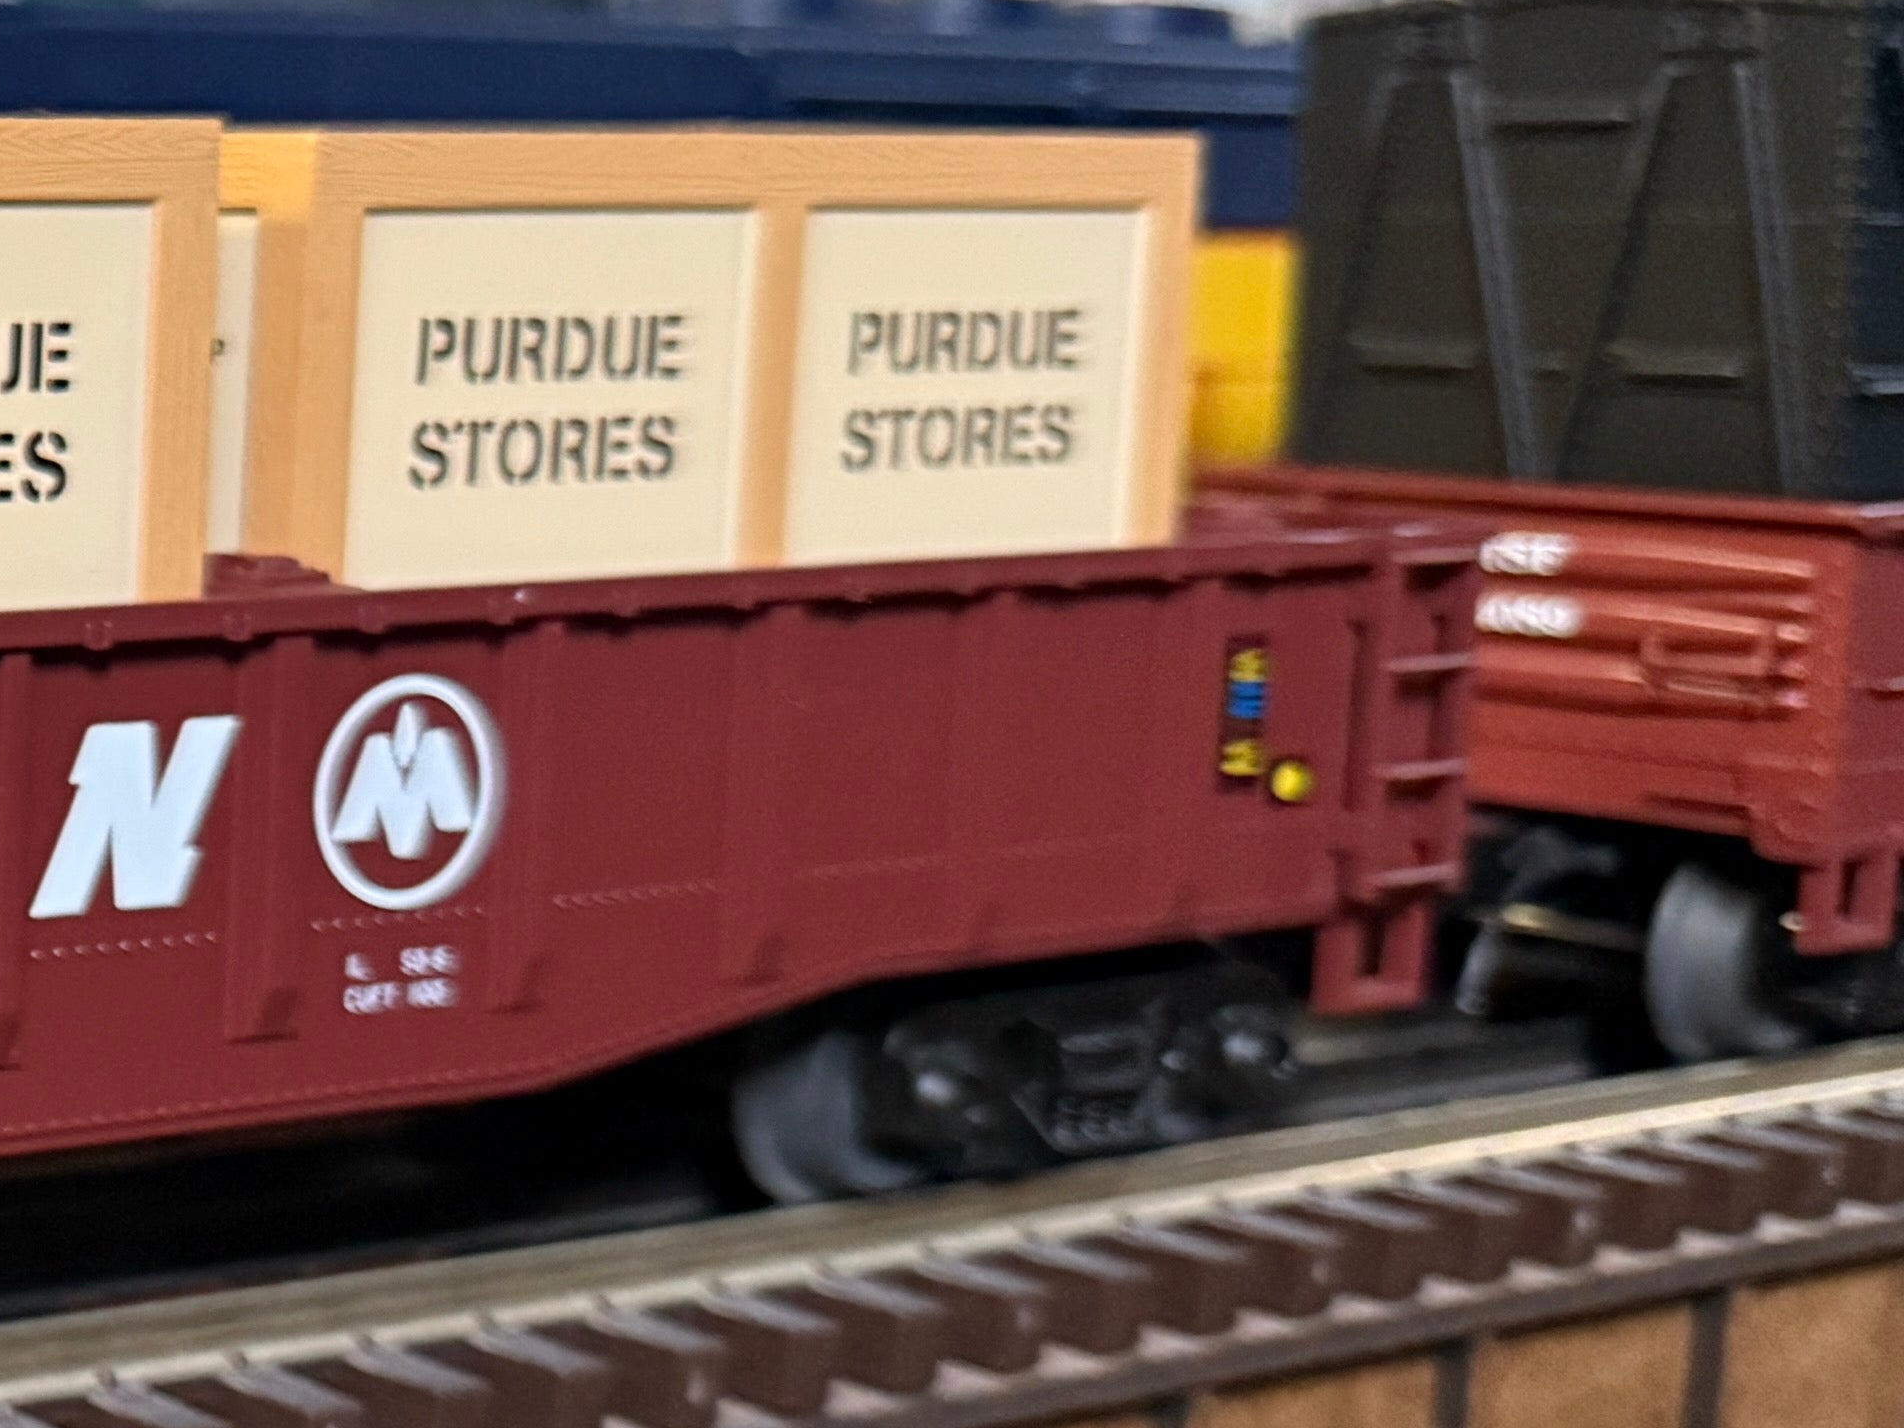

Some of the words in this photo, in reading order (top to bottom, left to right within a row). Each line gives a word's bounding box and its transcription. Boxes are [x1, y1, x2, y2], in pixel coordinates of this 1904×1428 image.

[415, 314, 685, 384] PURDUE
[849, 308, 1083, 372] PURDUE
[408, 415, 677, 489] STORES
[841, 404, 1073, 470] STORES
